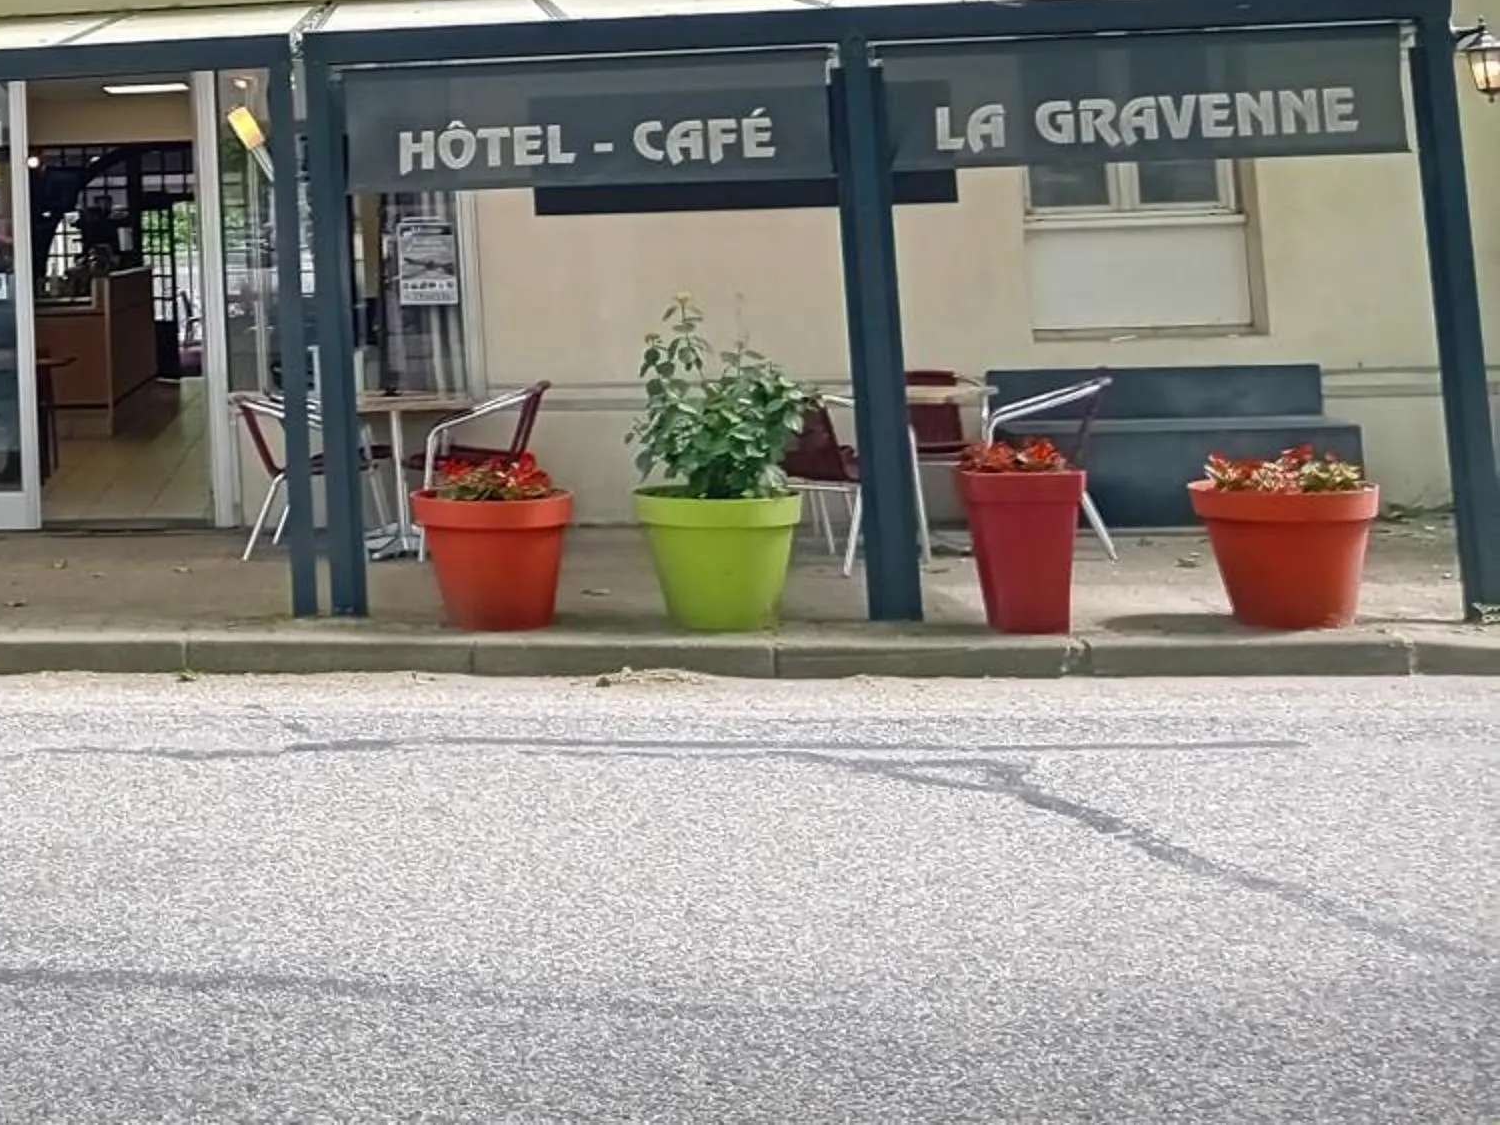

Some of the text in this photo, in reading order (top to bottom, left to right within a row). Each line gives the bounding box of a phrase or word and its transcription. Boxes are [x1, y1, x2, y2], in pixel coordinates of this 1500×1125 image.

[399, 120, 577, 175] HÔTEL
[633, 107, 777, 166] CAFÉ
[935, 86, 1359, 154] LA GRAVENNE
